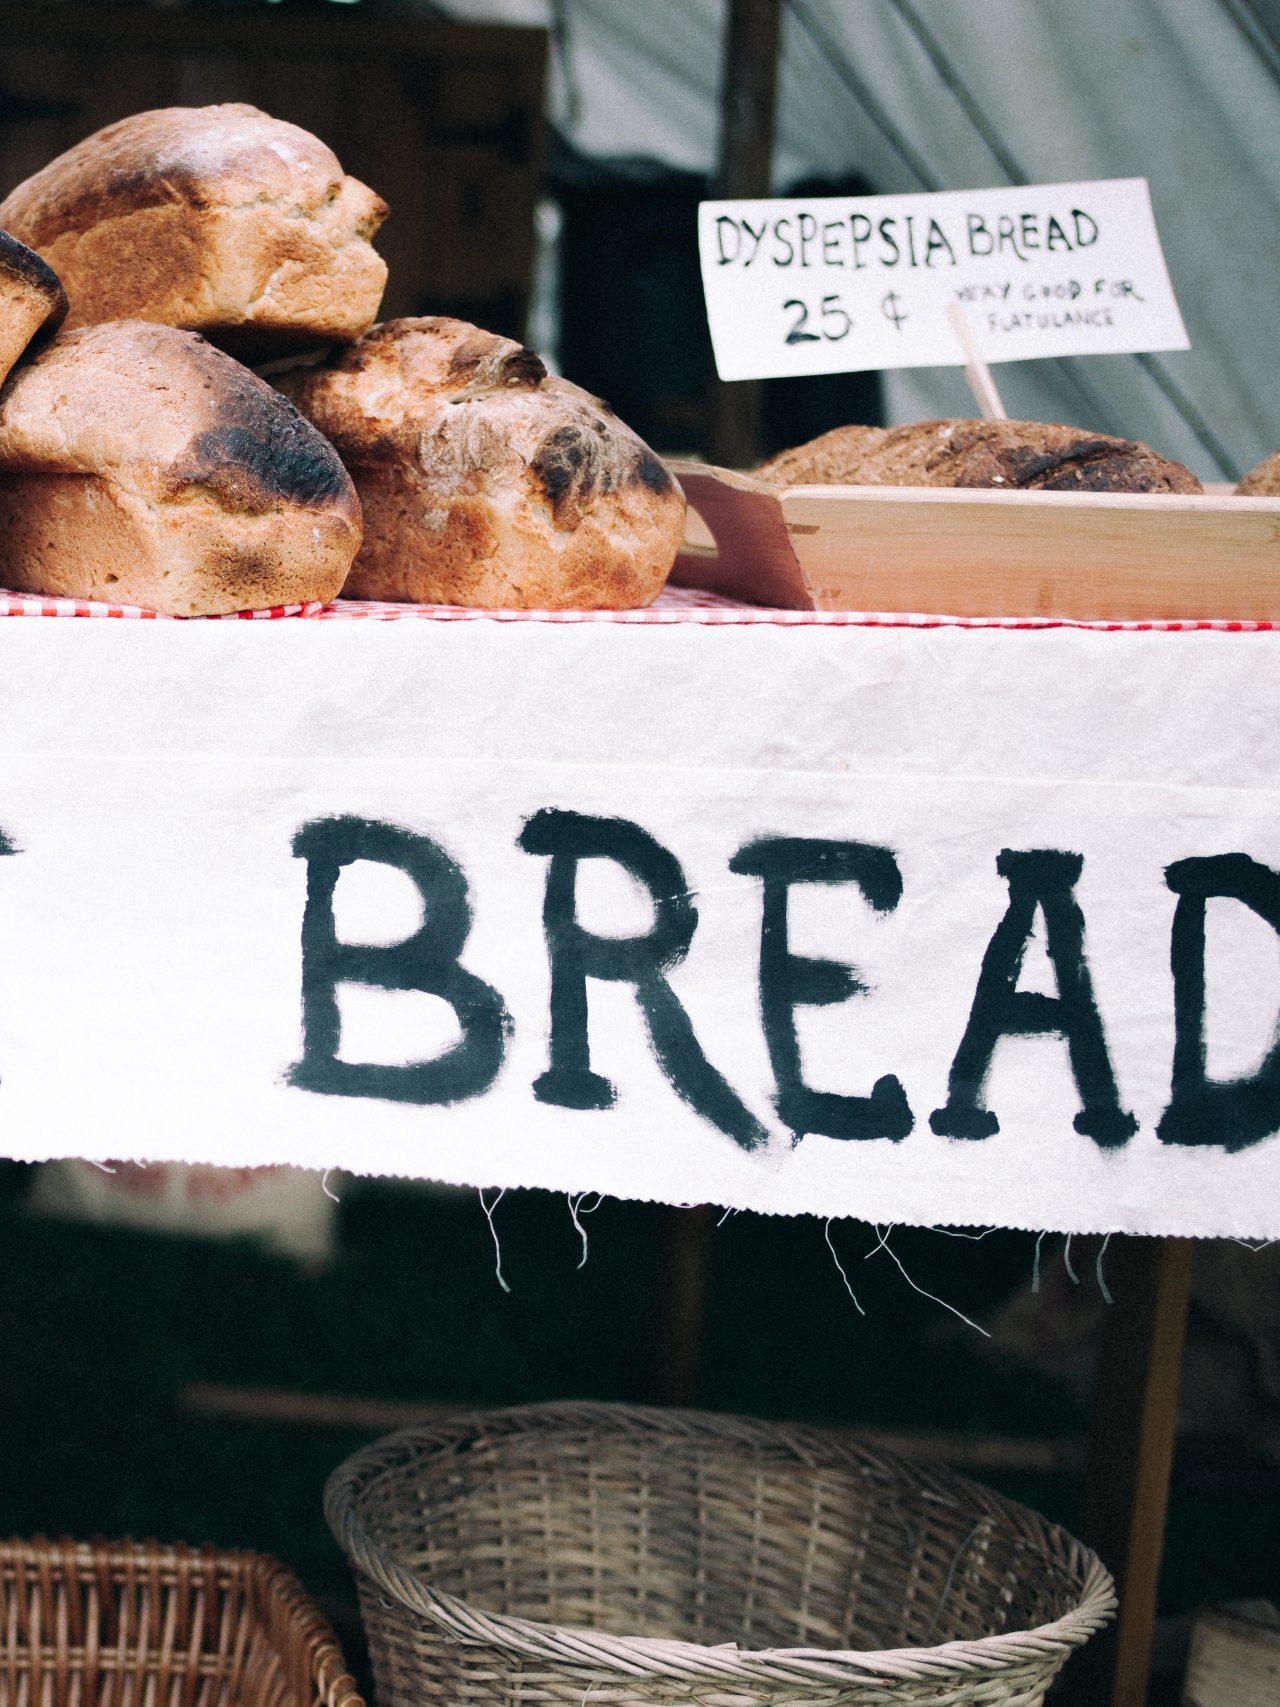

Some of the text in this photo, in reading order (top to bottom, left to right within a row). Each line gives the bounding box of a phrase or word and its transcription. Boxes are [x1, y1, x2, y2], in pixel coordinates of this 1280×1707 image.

[715, 208, 1099, 268] DYSPEPSIA BREAD
[1023, 280, 1081, 301] GOOD
[1095, 279, 1145, 302] FOR
[783, 296, 853, 346] 25
[286, 806, 1280, 1153] BREAD
